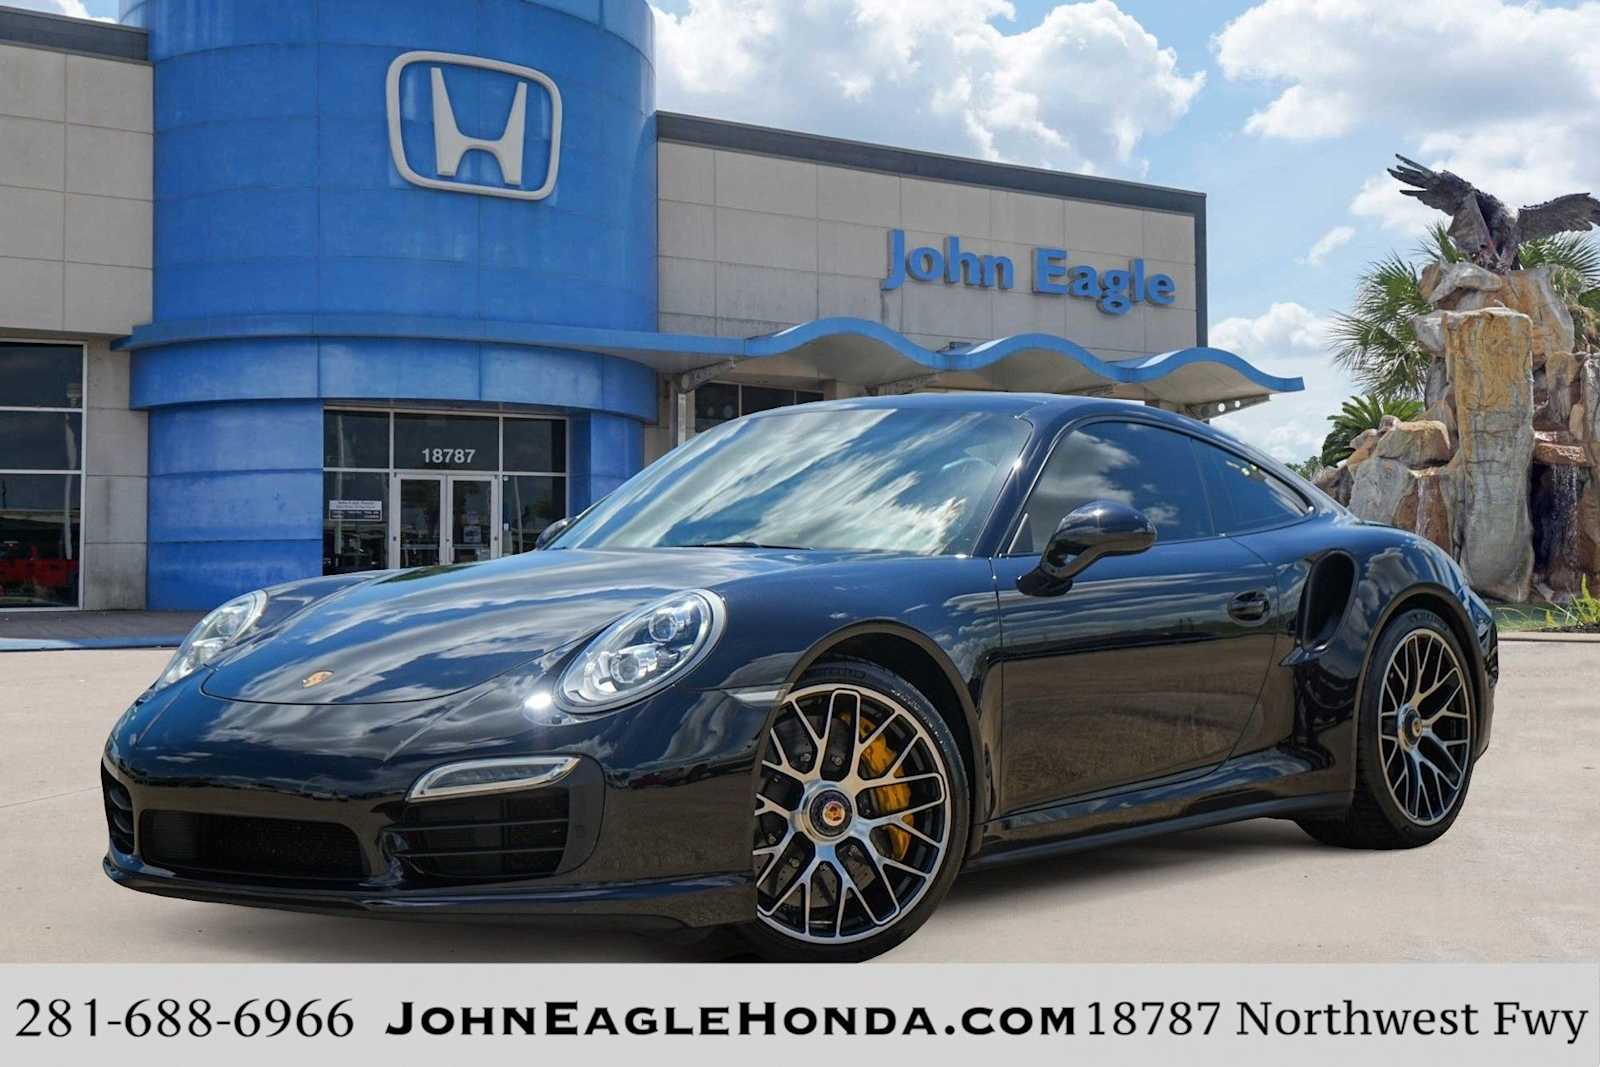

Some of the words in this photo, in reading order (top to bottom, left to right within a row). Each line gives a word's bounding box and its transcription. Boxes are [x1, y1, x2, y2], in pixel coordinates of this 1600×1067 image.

[880, 228, 1014, 291] John
[1031, 247, 1176, 316] Eagle
[421, 448, 476, 464] 18787
